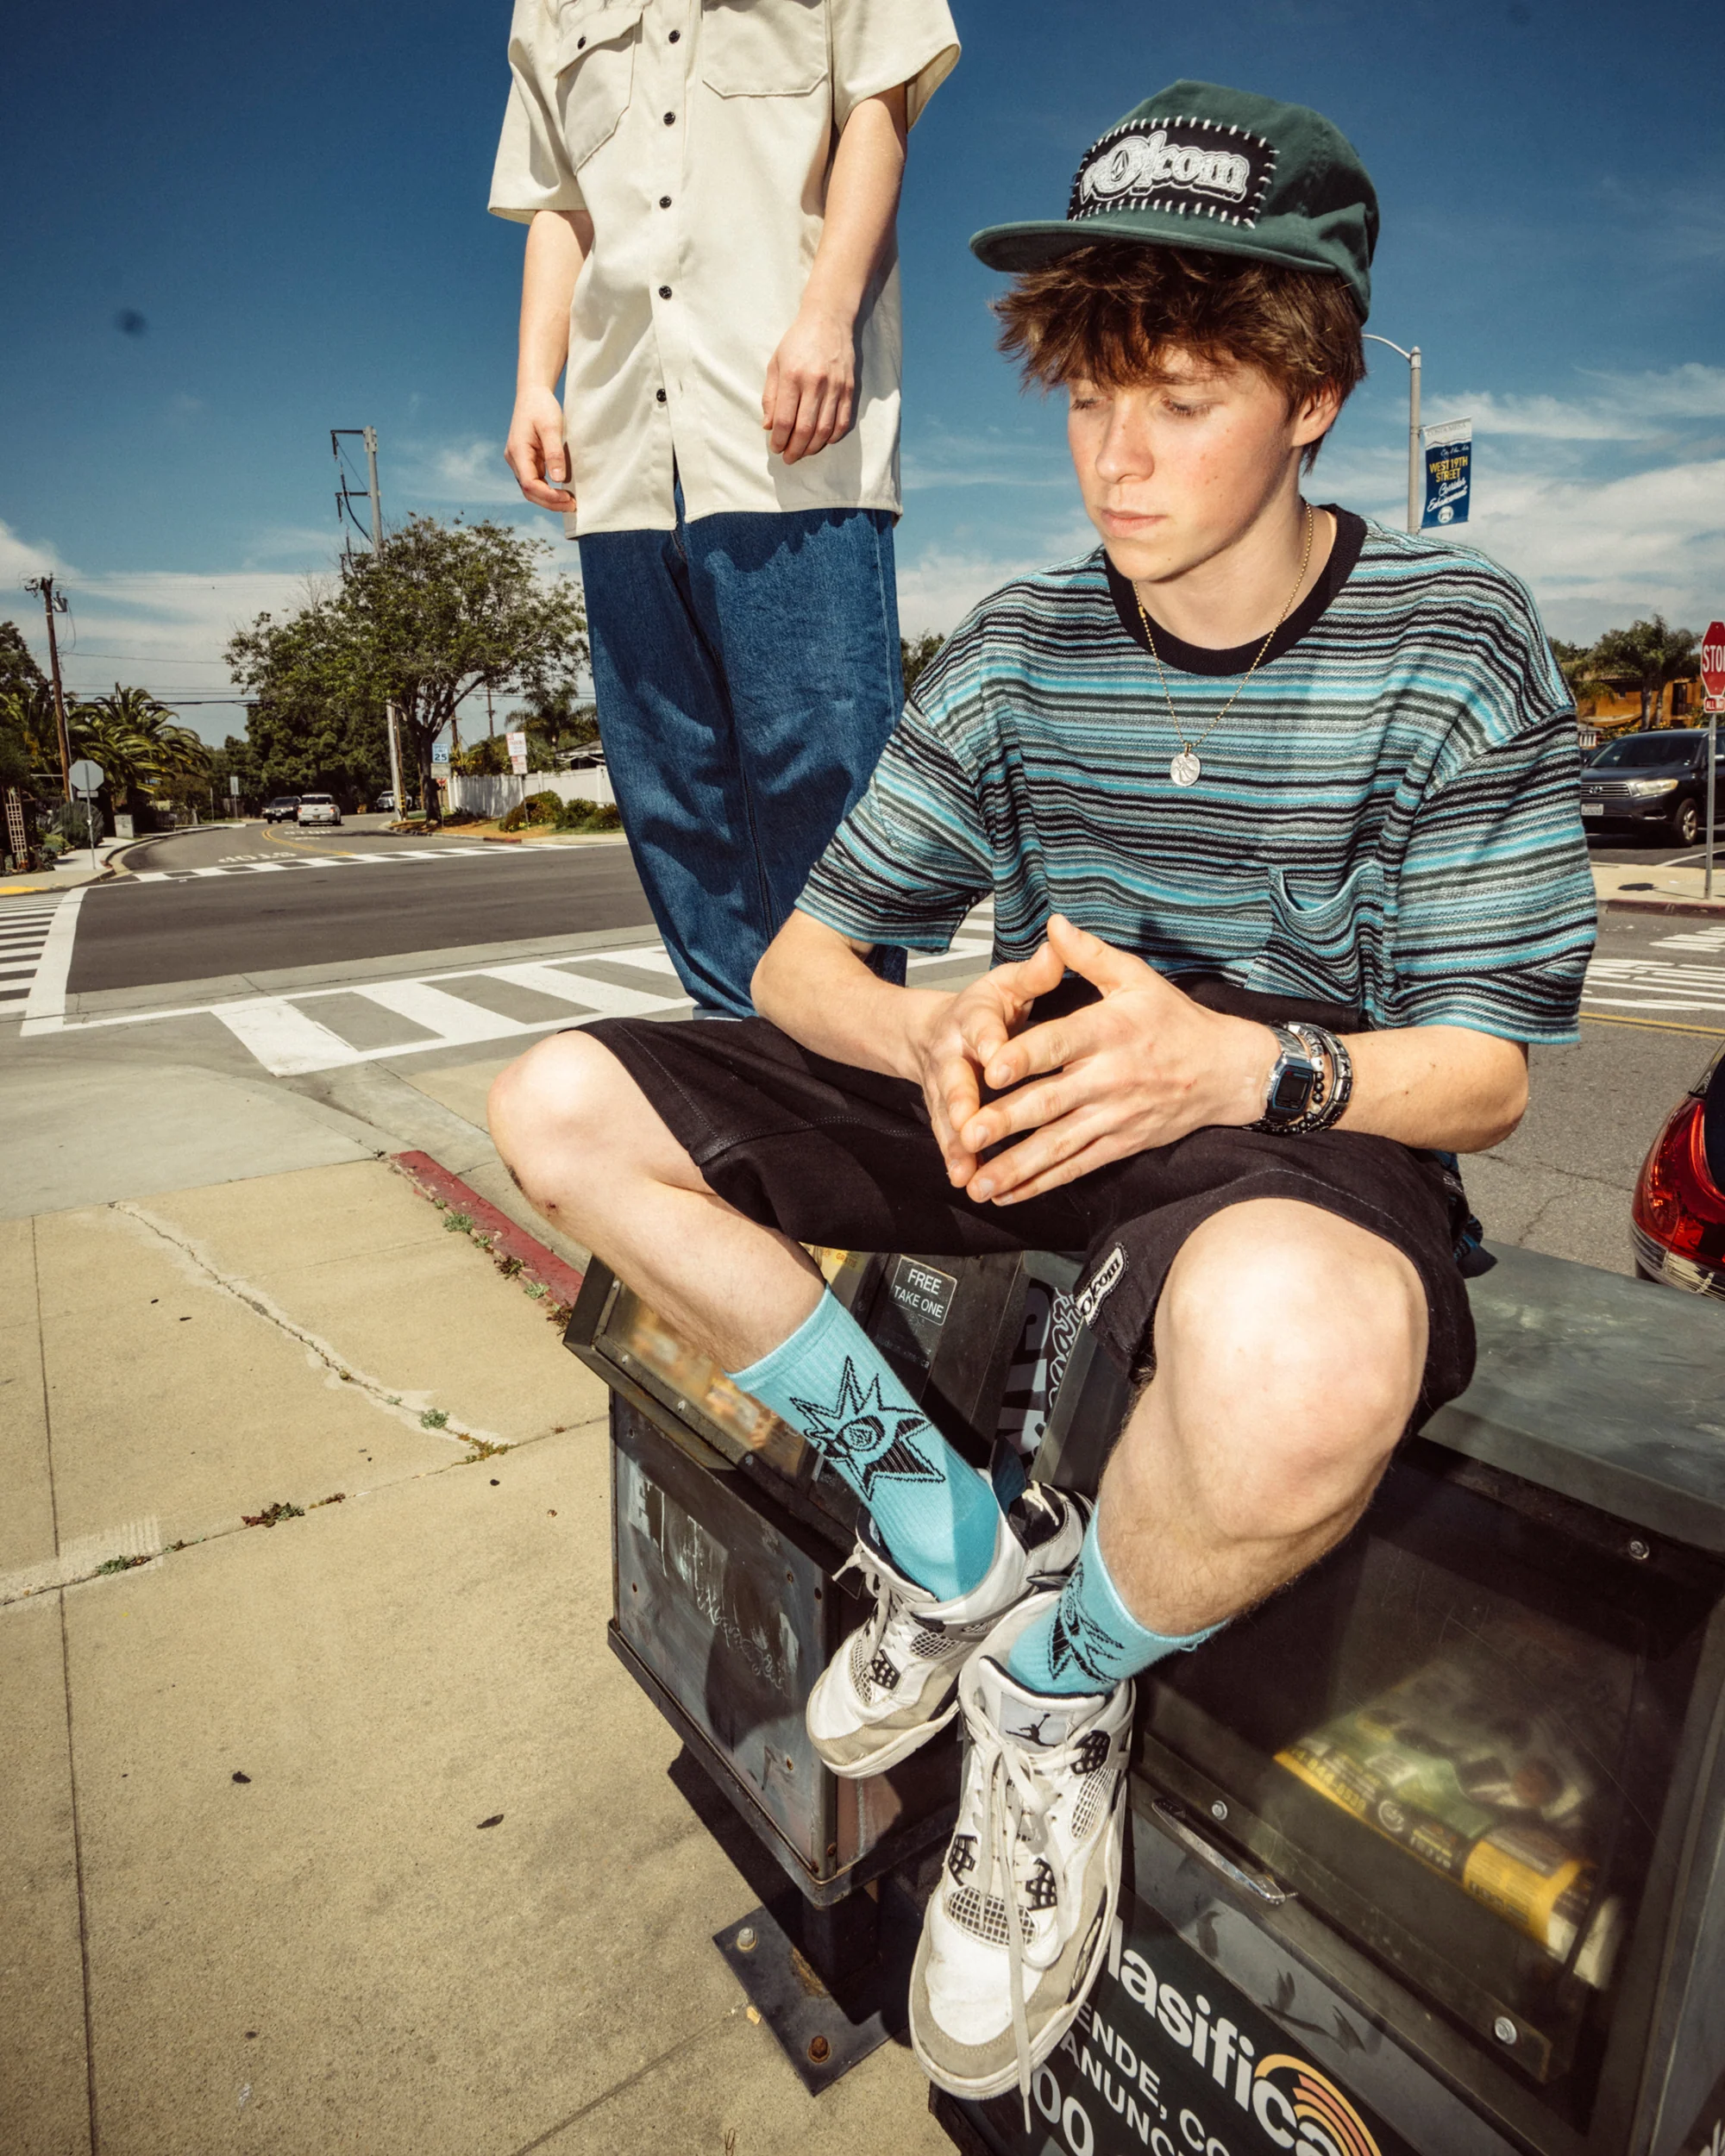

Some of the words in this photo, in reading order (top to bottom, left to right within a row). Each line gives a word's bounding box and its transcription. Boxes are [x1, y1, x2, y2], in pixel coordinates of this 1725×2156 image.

[1429, 460, 1449, 473] WEST
[1451, 456, 1468, 468] 19TH
[1435, 467, 1461, 482] STREET
[434, 753, 448, 761] 25
[907, 1269, 942, 1295] FREE
[1081, 1258, 1120, 1316] olcom
[894, 1285, 921, 1307] TAKE
[920, 1299, 944, 1319] ONE
